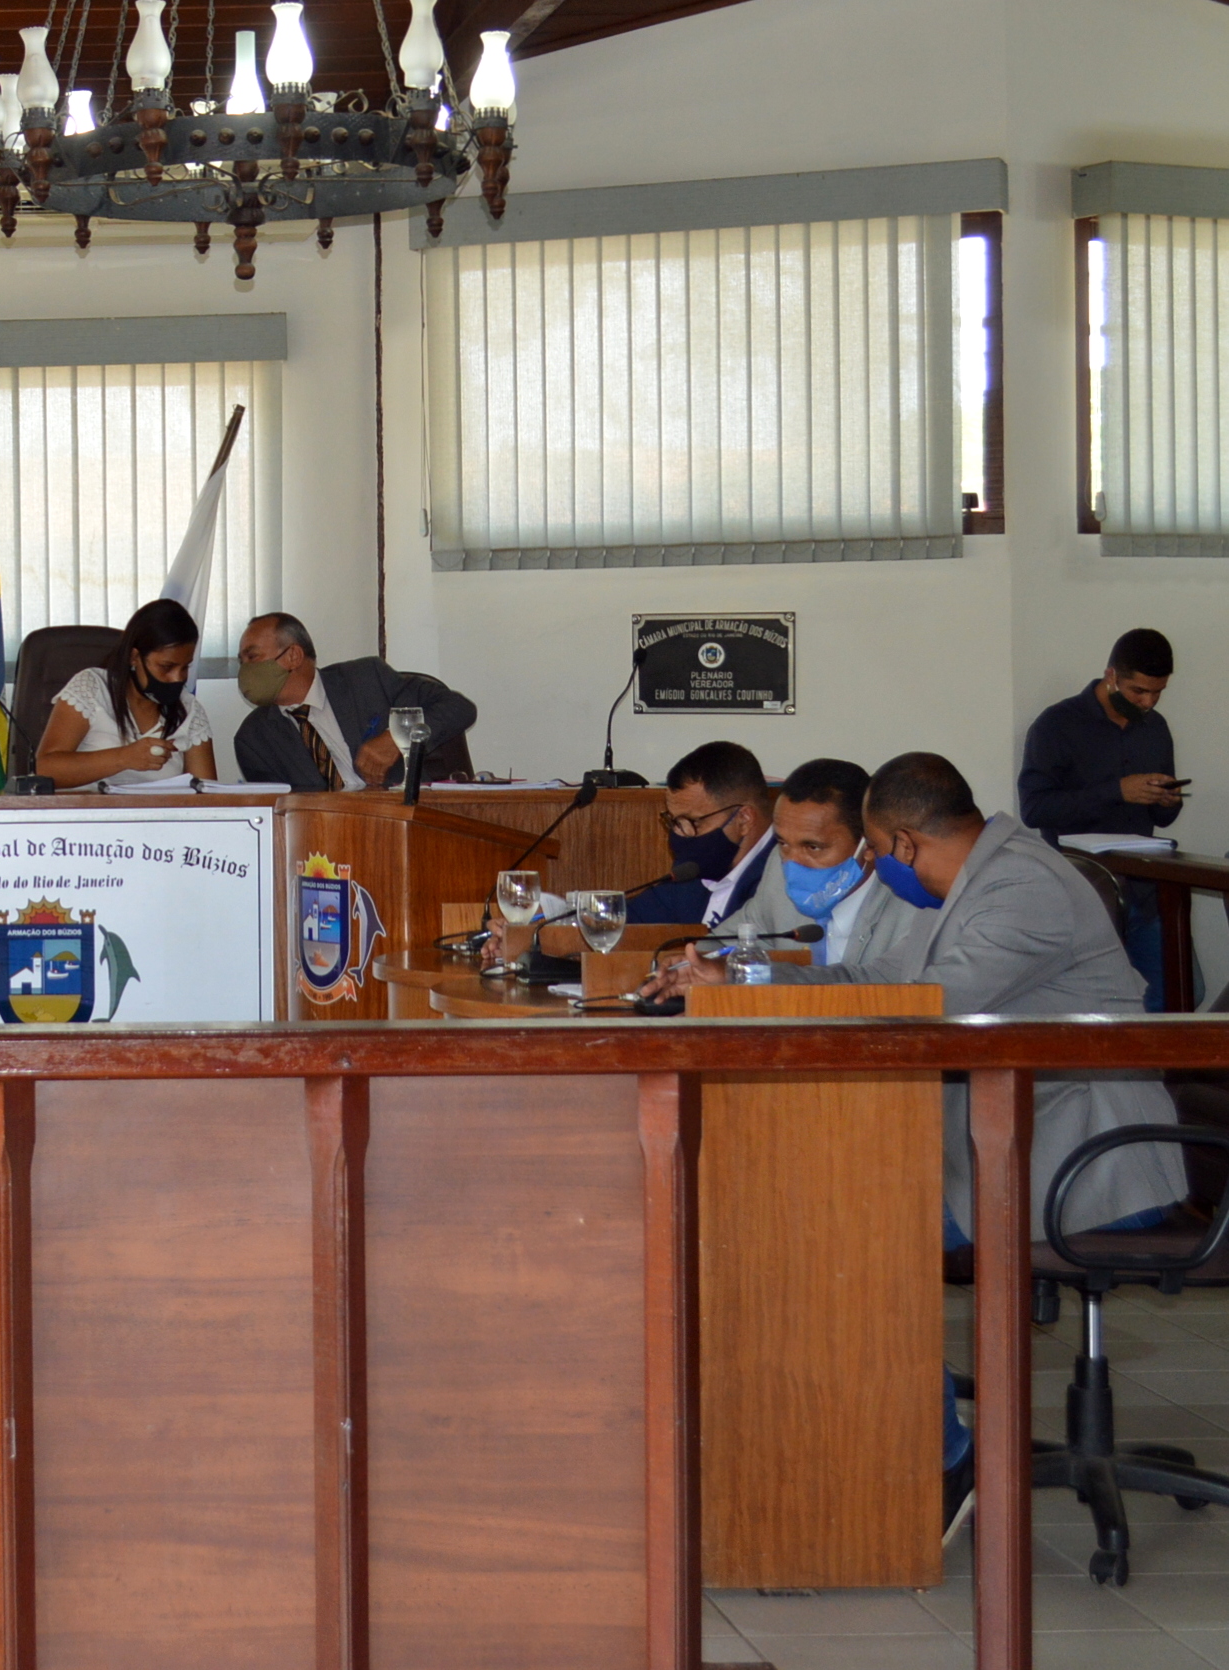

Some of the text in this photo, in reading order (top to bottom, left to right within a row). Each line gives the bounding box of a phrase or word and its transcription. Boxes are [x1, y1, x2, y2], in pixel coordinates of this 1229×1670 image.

[638, 619, 789, 649] CÂMARA MUNICIPAL DE ARMAÇÃO DOS BÚZIOS
[690, 670, 733, 680] PLENÁRIO
[690, 680, 734, 688] VEREADOR
[655, 688, 774, 702] EMÍGDIO GONÇALVES COUTINHO
[27, 839, 47, 856] de
[51, 837, 135, 865] Armação
[141, 843, 175, 863] dos
[181, 847, 251, 879] Búzios
[13, 876, 29, 889] do
[33, 876, 54, 889] Rio
[55, 876, 71, 889] de
[75, 876, 124, 889] Janeiro
[7, 928, 41, 937] ARMAÇÃO
[57, 928, 82, 936] BÚZIOS
